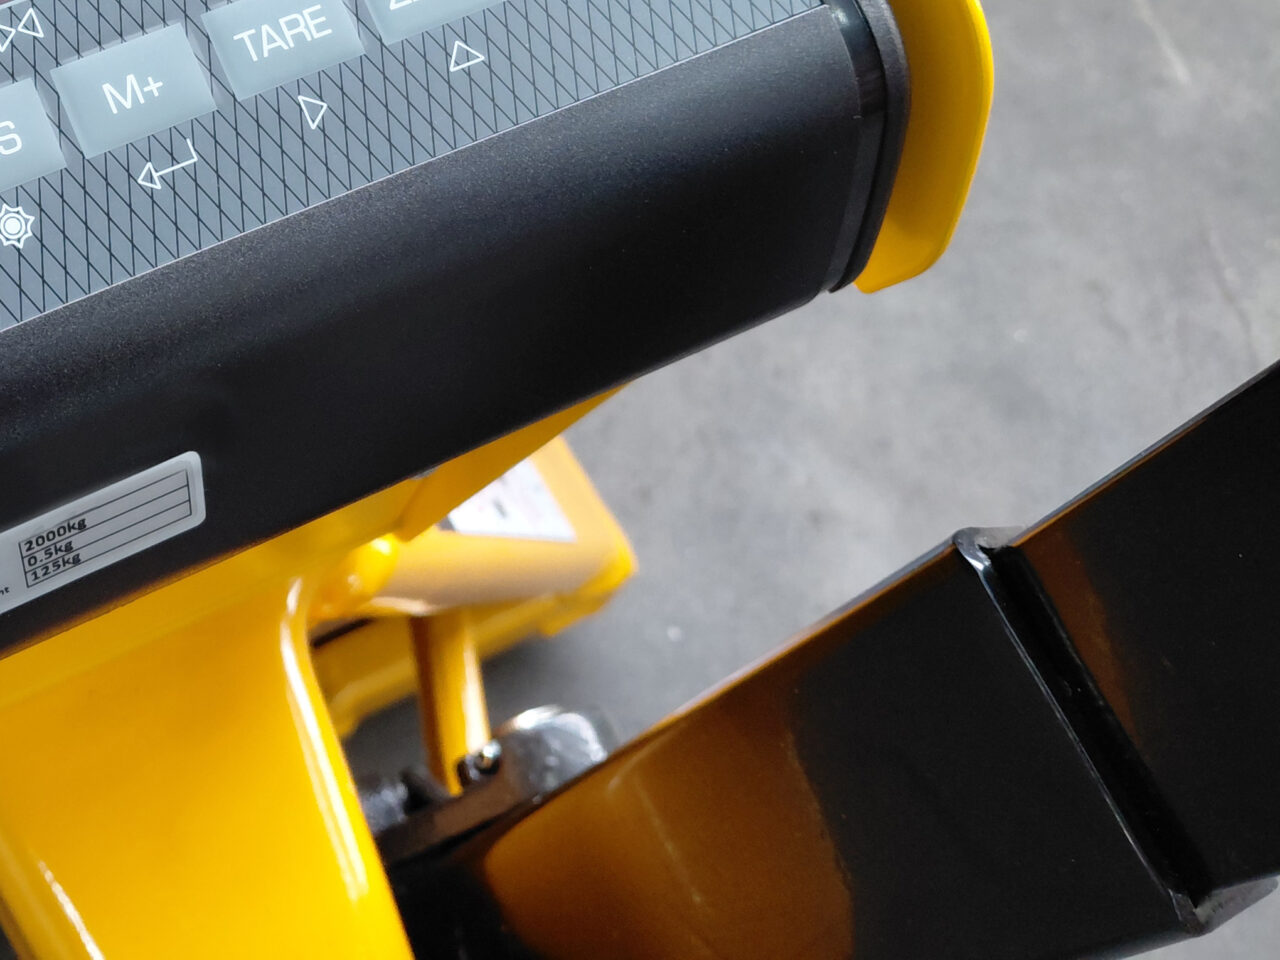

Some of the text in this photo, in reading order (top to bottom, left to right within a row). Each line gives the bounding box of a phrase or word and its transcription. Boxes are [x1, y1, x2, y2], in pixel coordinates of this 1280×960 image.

[232, 4, 333, 63] TARE
[101, 73, 164, 115] M+
[24, 516, 88, 553] 2000kg
[27, 538, 74, 567] 0.5kg
[30, 552, 82, 581] 125kg
